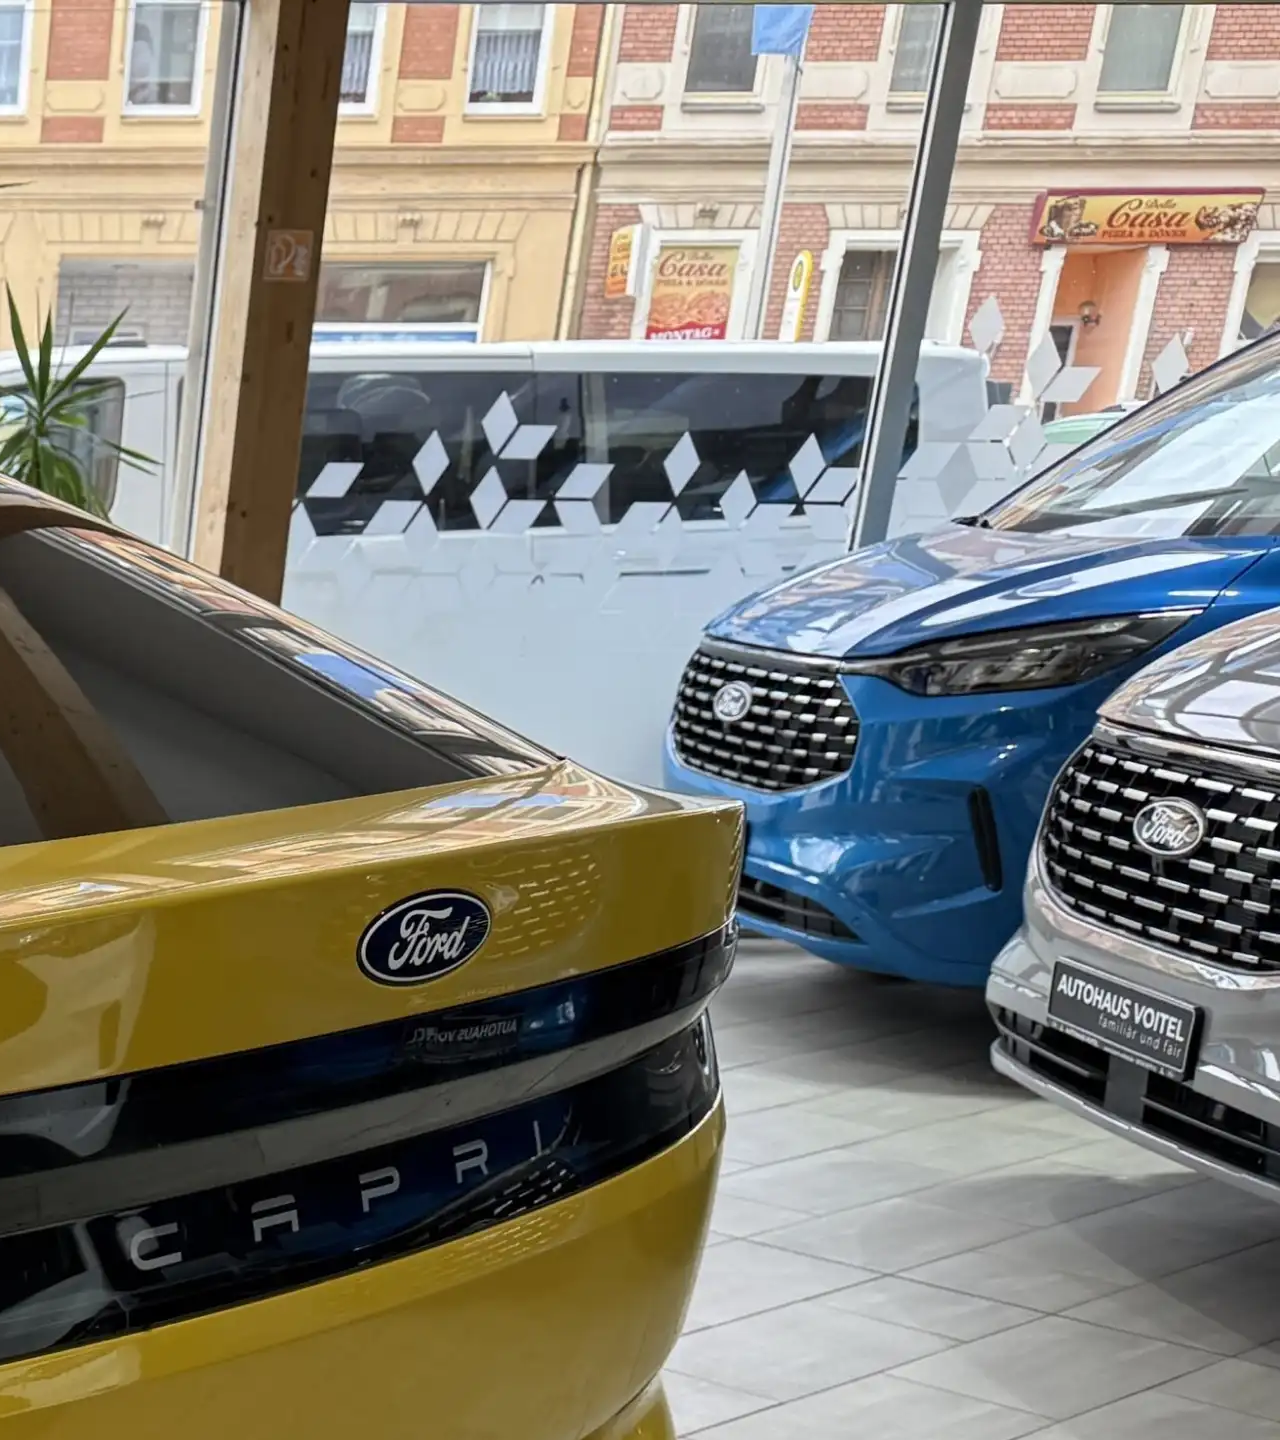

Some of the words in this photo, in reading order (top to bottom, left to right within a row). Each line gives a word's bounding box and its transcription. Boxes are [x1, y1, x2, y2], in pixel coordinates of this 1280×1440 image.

[1106, 198, 1190, 229] Casa
[659, 250, 727, 277] Casa
[1142, 807, 1192, 848] Ford
[388, 906, 470, 970] Ford
[1057, 974, 1132, 1020] AUTOHAUS
[1134, 1002, 1184, 1042] VOITEL
[1098, 1013, 1138, 1040] familiär
[1140, 1033, 1160, 1050] und
[1163, 1039, 1182, 1058] fair
[130, 1119, 541, 1271] CAPRI
